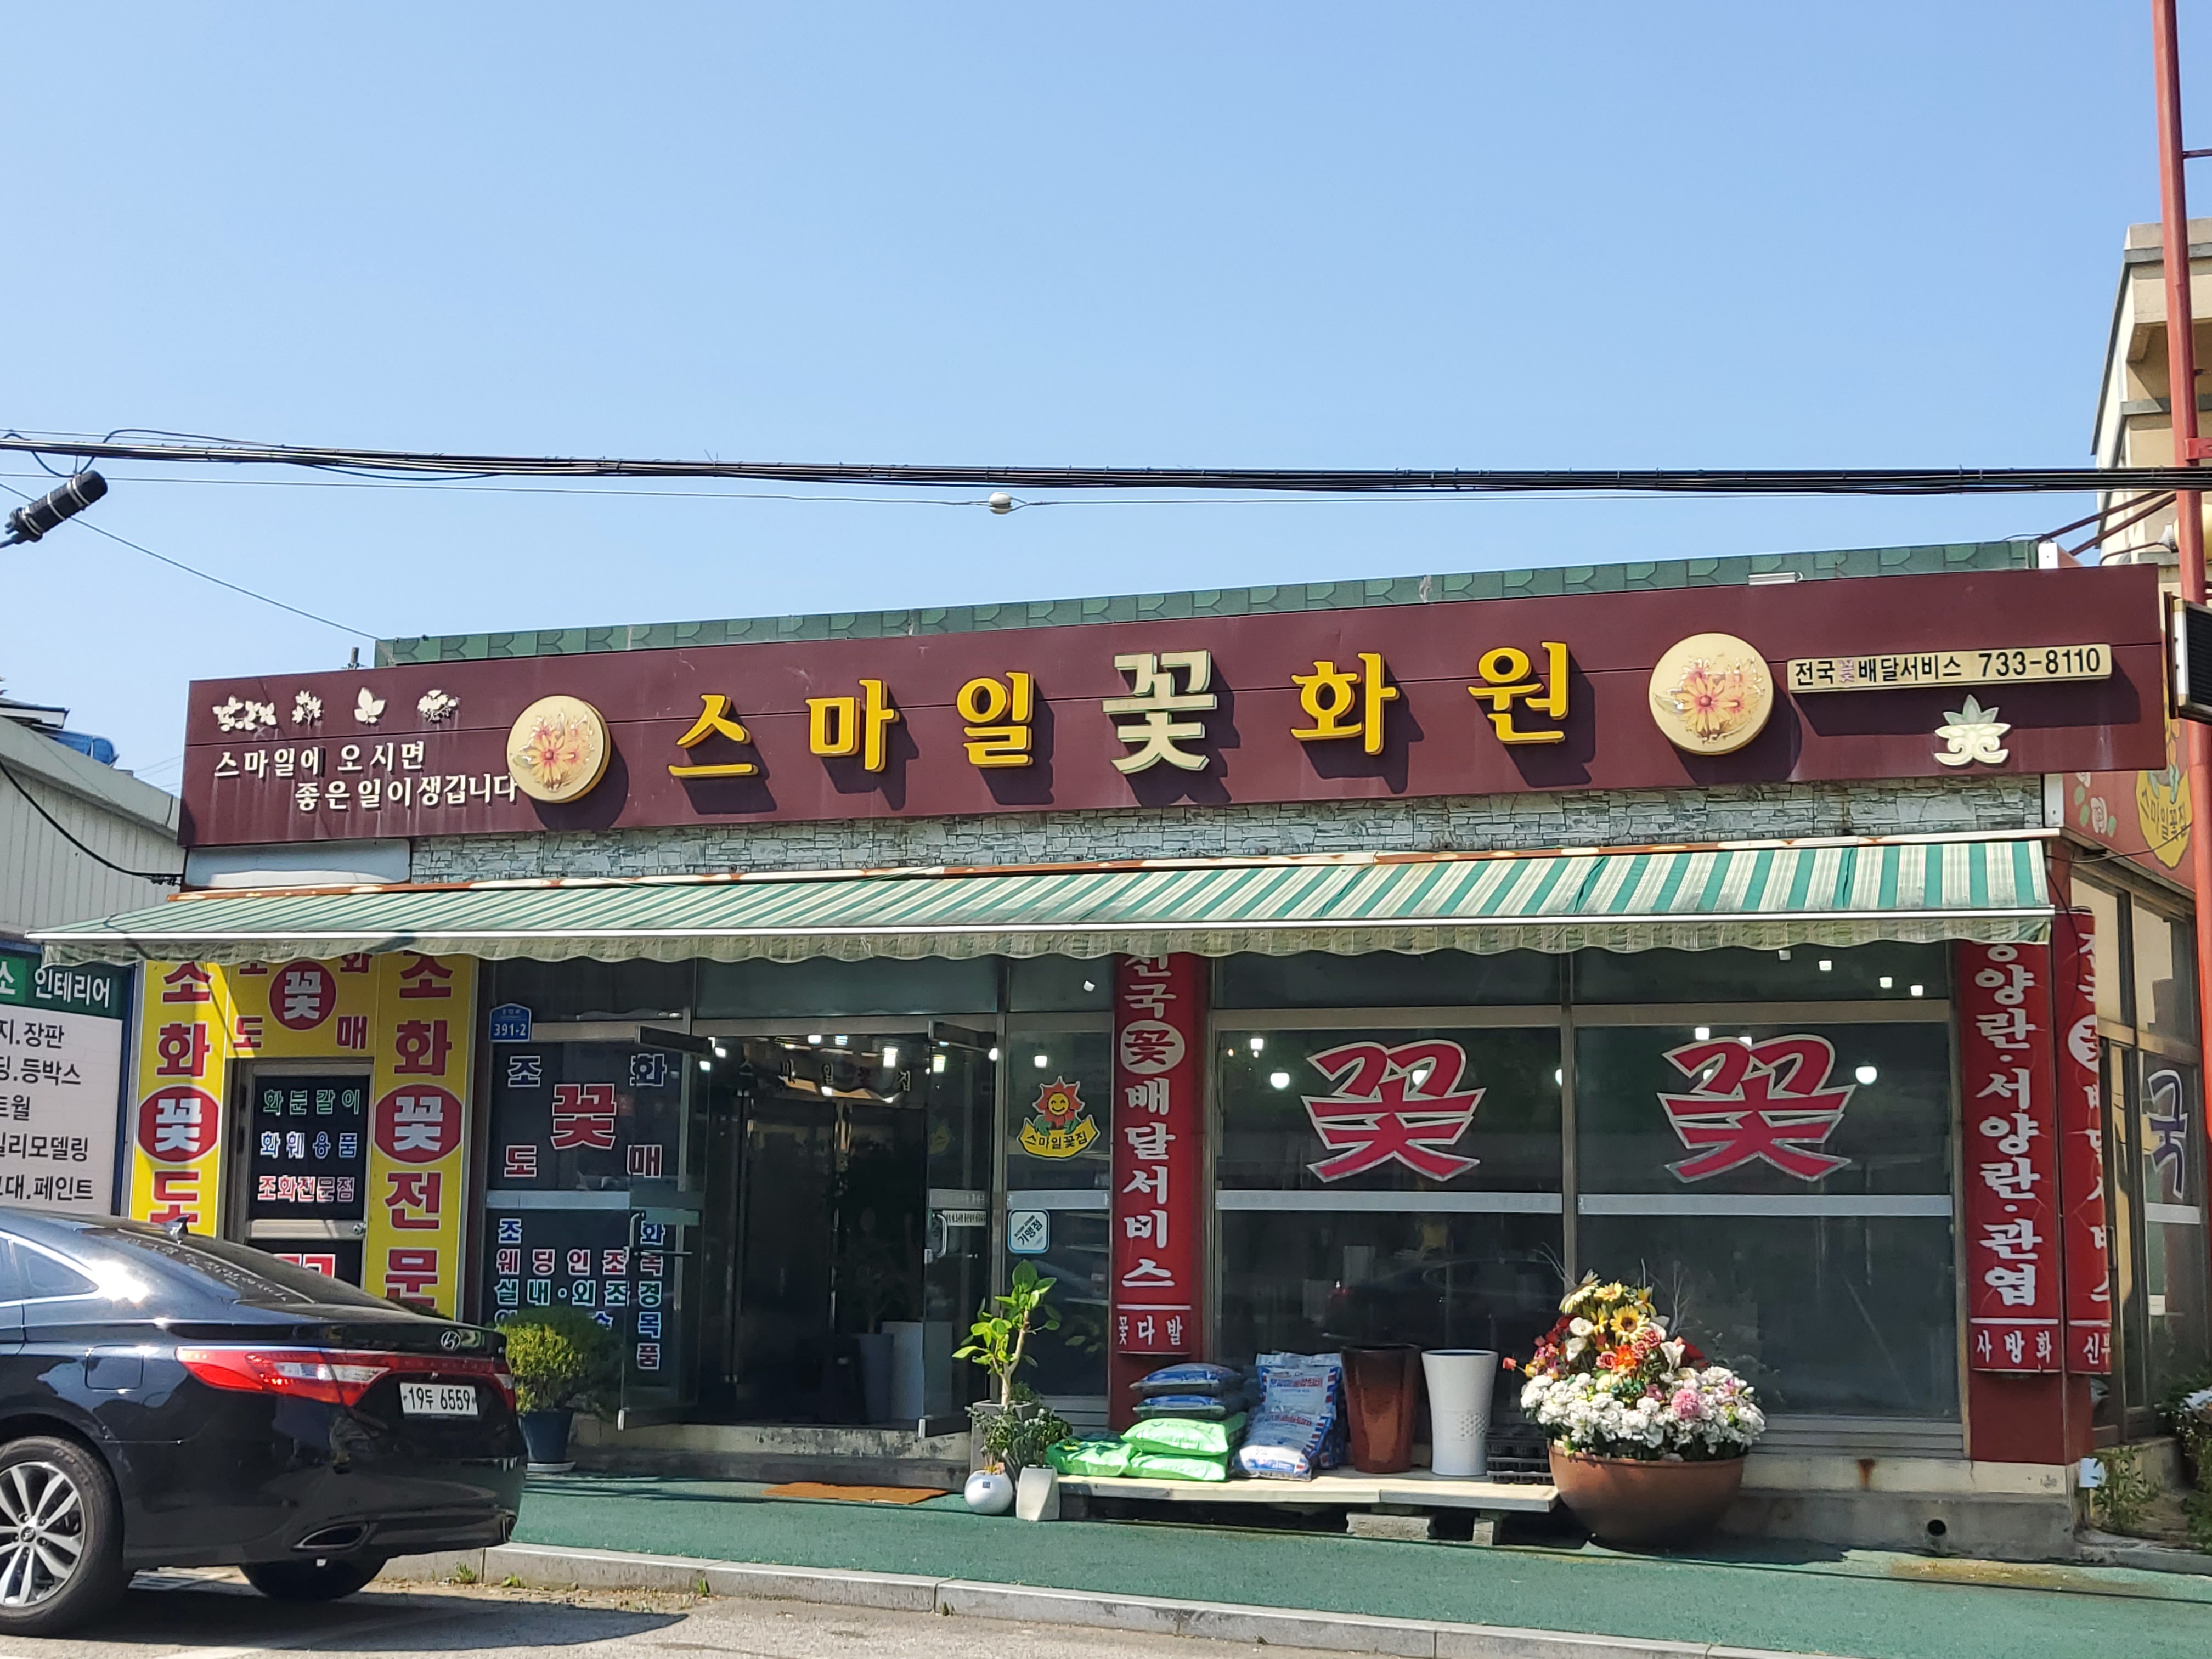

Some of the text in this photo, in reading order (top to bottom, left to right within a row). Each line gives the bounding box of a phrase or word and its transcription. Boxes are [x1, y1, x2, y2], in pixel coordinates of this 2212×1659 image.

[1979, 647, 2100, 678] 733-8110
[337, 741, 425, 774] 오시면
[417, 773, 519, 806] 생깁니다
[35, 968, 110, 1009] 인테리어
[283, 971, 322, 1020] 꽃
[494, 1023, 527, 1037] 391-2
[263, 1088, 360, 1116] 화분갈이
[550, 1083, 617, 1150] 꽃
[1301, 1040, 1487, 1183] 꽃
[1656, 1034, 1858, 1184] 꽃
[1024, 1130, 1088, 1150] 스마일꽃집
[257, 1175, 355, 1202] 조화전문점
[1119, 1314, 1183, 1346] 꽃다발
[408, 1386, 470, 1411] 19두 6559
